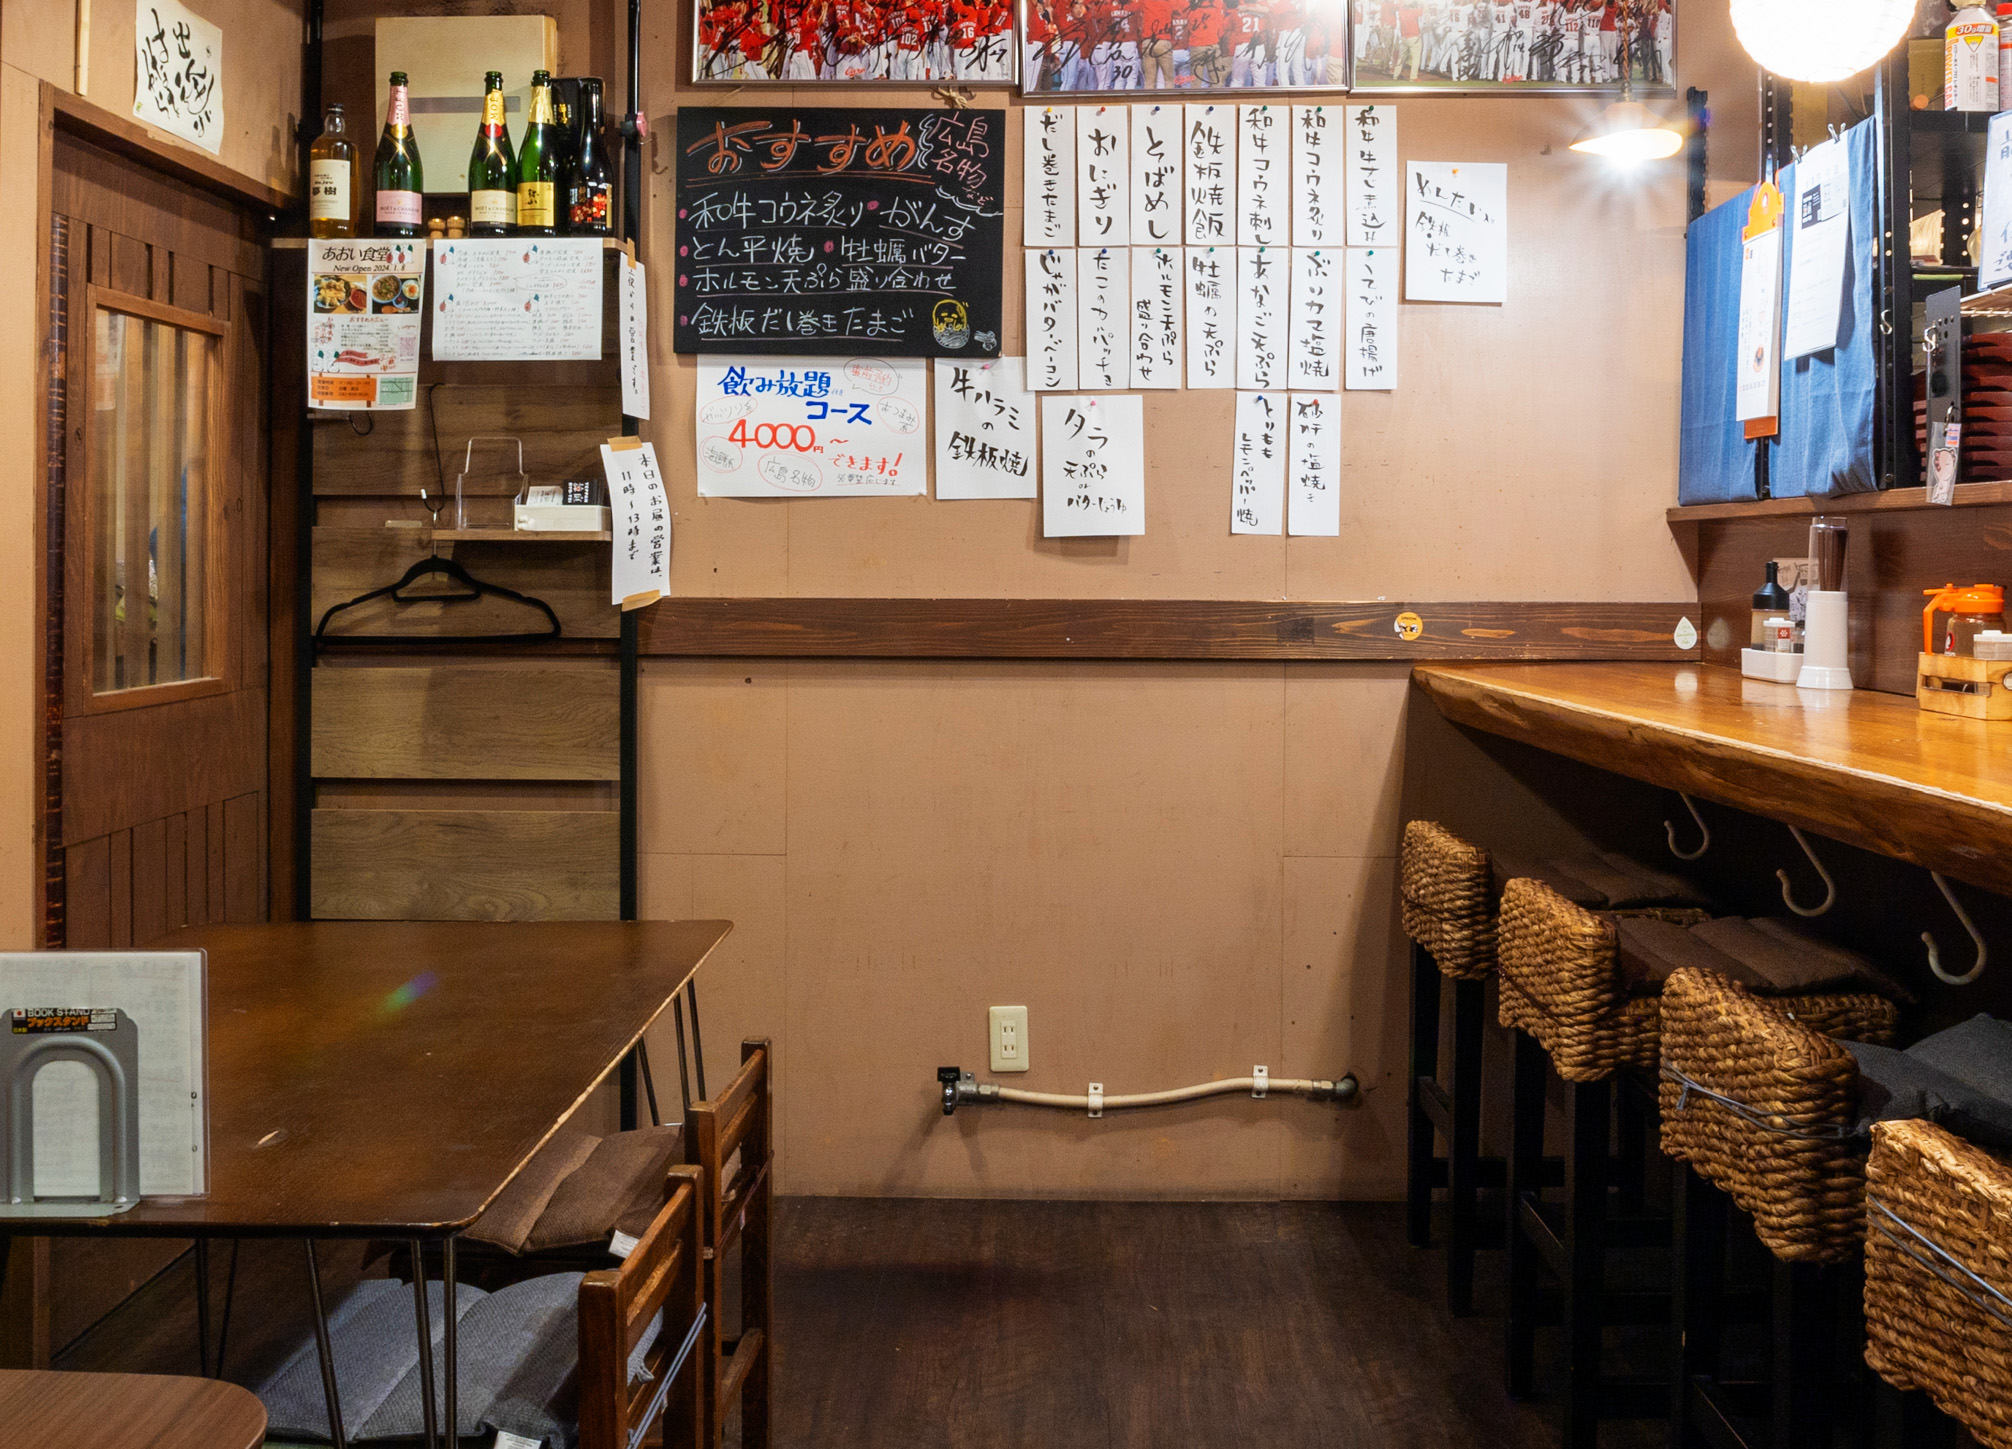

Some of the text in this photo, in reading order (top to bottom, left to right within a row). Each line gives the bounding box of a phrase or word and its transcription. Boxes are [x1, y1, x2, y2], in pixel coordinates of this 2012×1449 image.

[900, 34, 918, 46] 102
[962, 27, 975, 39] 16
[1242, 17, 1259, 33] 21
[687, 119, 920, 174] おすすめ
[927, 111, 989, 158] 広島
[931, 148, 988, 189] 名物
[1039, 114, 1065, 238] だし巻きたまご
[1088, 128, 1117, 236] おにぎり
[1144, 126, 1175, 239] とばめし
[1190, 120, 1226, 239] 鉄板焼飯
[1245, 108, 1273, 244] 和牛コウネ刺し
[689, 191, 863, 230] 和牛コウネ炙り
[879, 195, 976, 242] がんす
[322, 246, 391, 262] あおい食堂
[840, 235, 966, 264] 牡蠣バター
[333, 264, 351, 272] New
[352, 264, 372, 274] Open
[692, 264, 956, 294] ホルモン天ぷら盛り合わせ
[1440, 268, 1480, 285] たまご
[691, 302, 915, 336] 鉄板だし巻きたまご
[1249, 254, 1275, 388] あなご天ぷら
[717, 366, 831, 399] 飲み放題
[950, 367, 1020, 431] 牛ハラミ
[805, 400, 872, 425] コース
[981, 421, 994, 431] の
[1064, 408, 1109, 450] タラ
[1260, 398, 1275, 459] とりもも
[947, 431, 1030, 477] 鉄板焼
[1086, 449, 1096, 459] の
[1296, 400, 1326, 502] 砂肝の塩焼き
[766, 456, 817, 487] 広島名物
[1063, 460, 1108, 480] 天ぷら
[1078, 482, 1092, 490] or
[1236, 432, 1259, 527] レモンペッパー焼
[27, 1008, 91, 1017] BOOK STAND
[27, 1016, 90, 1028] ブックスタンド
